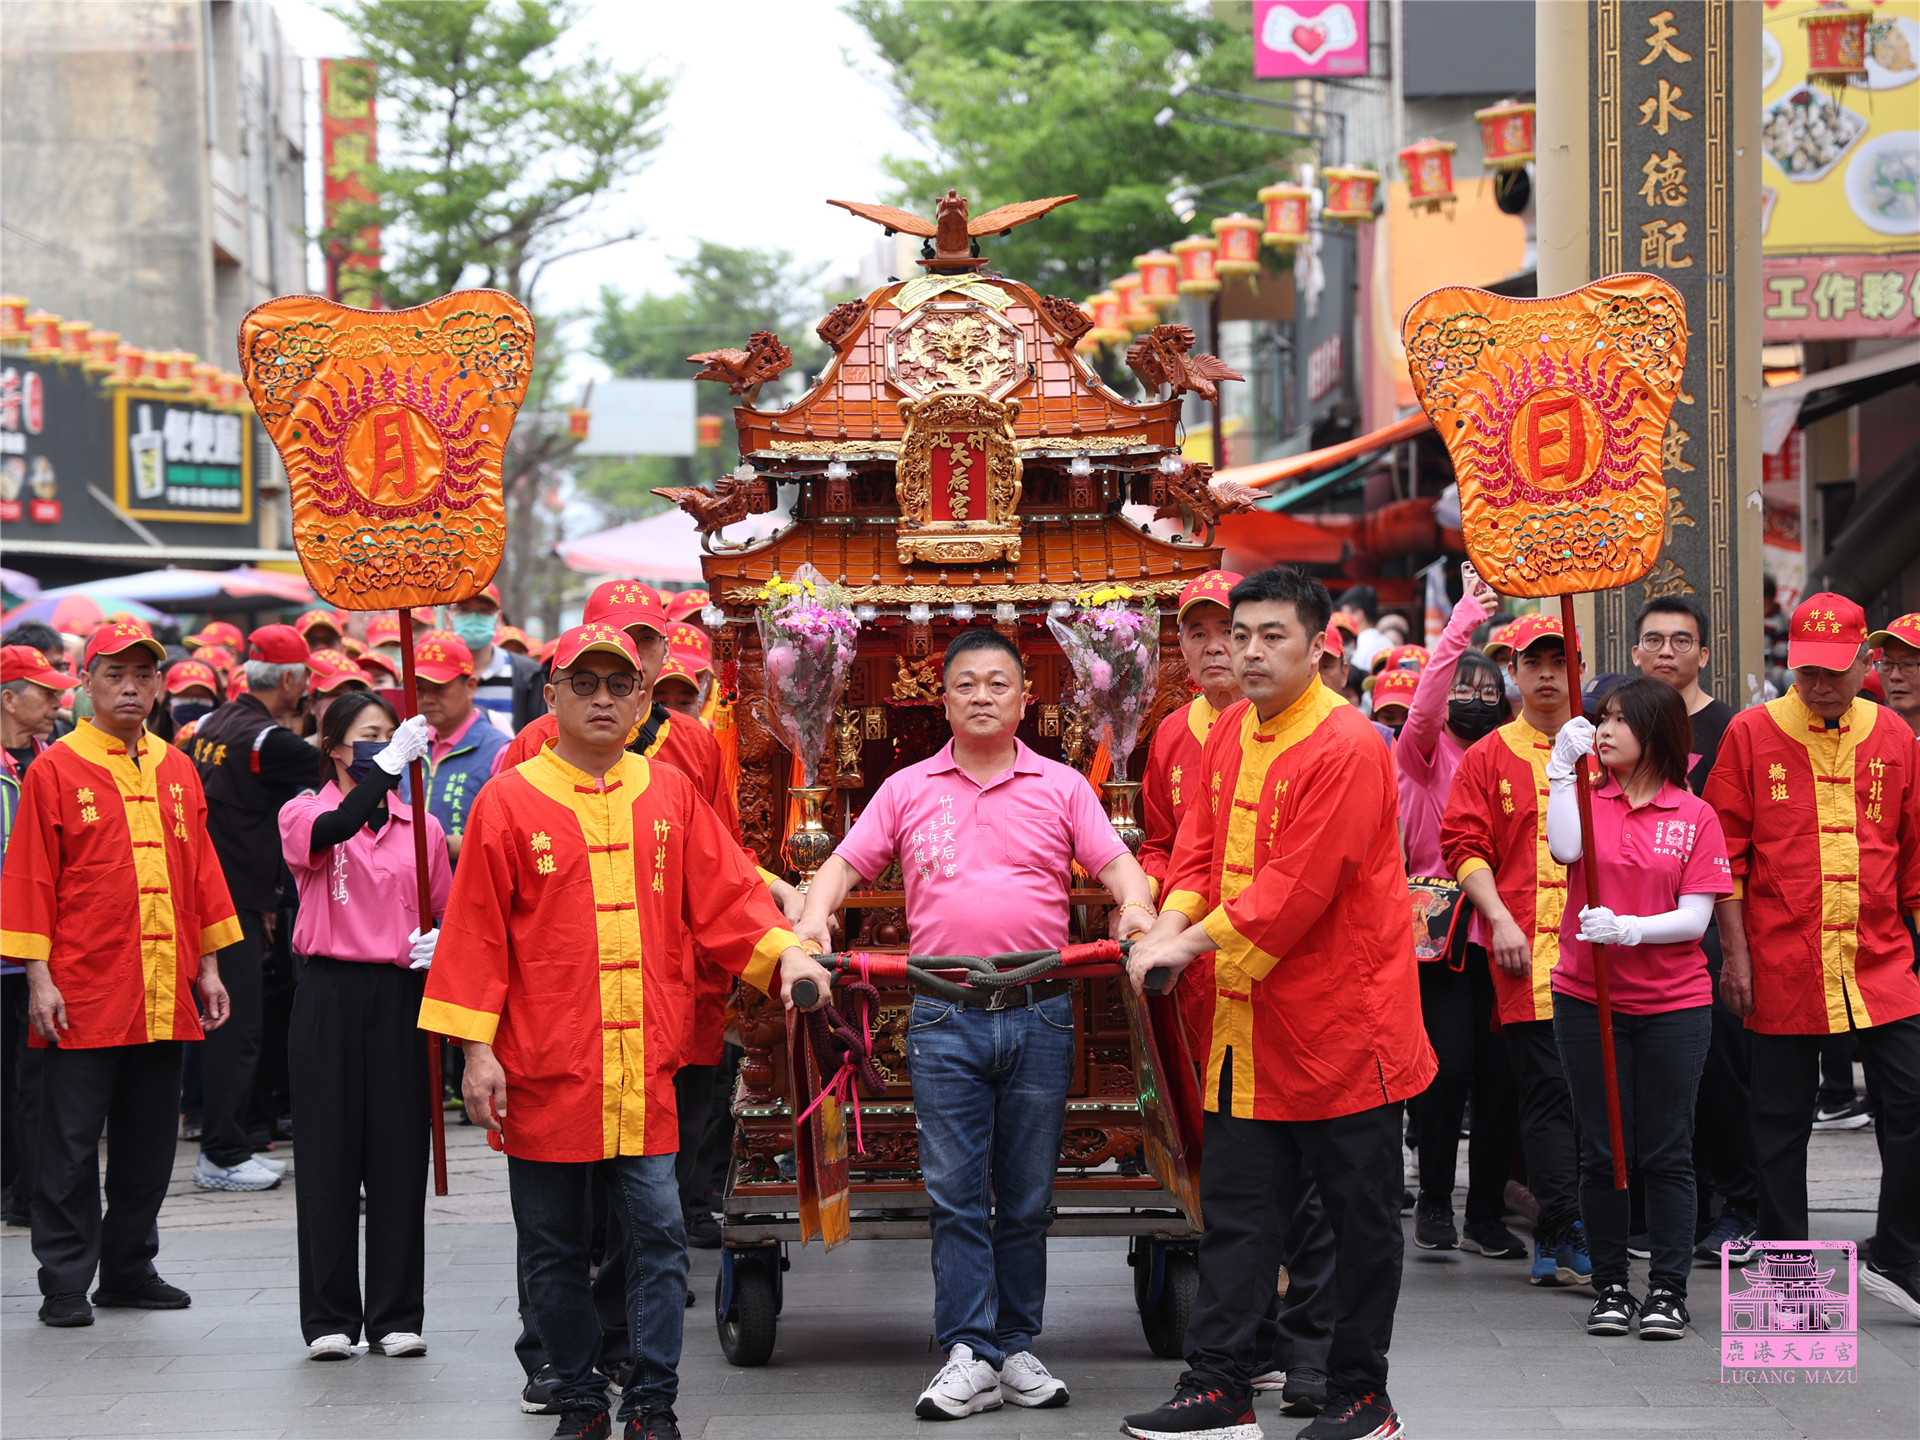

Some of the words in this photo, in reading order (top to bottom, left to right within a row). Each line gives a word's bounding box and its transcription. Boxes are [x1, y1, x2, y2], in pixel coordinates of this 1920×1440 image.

[370, 407, 417, 500] 月
[1527, 394, 1586, 484] 日
[947, 442, 974, 519] 天后宮
[608, 593, 651, 606] 天后宮
[614, 583, 643, 594] 竹北
[584, 623, 615, 634] 竹北
[1801, 620, 1843, 634] 天后宮
[1809, 609, 1836, 621] 竹北
[577, 631, 624, 646] 天后宮
[1865, 757, 1886, 824] 竹北媽
[927, 820, 941, 871] 主任委員
[938, 794, 957, 879] 竹北天后宮
